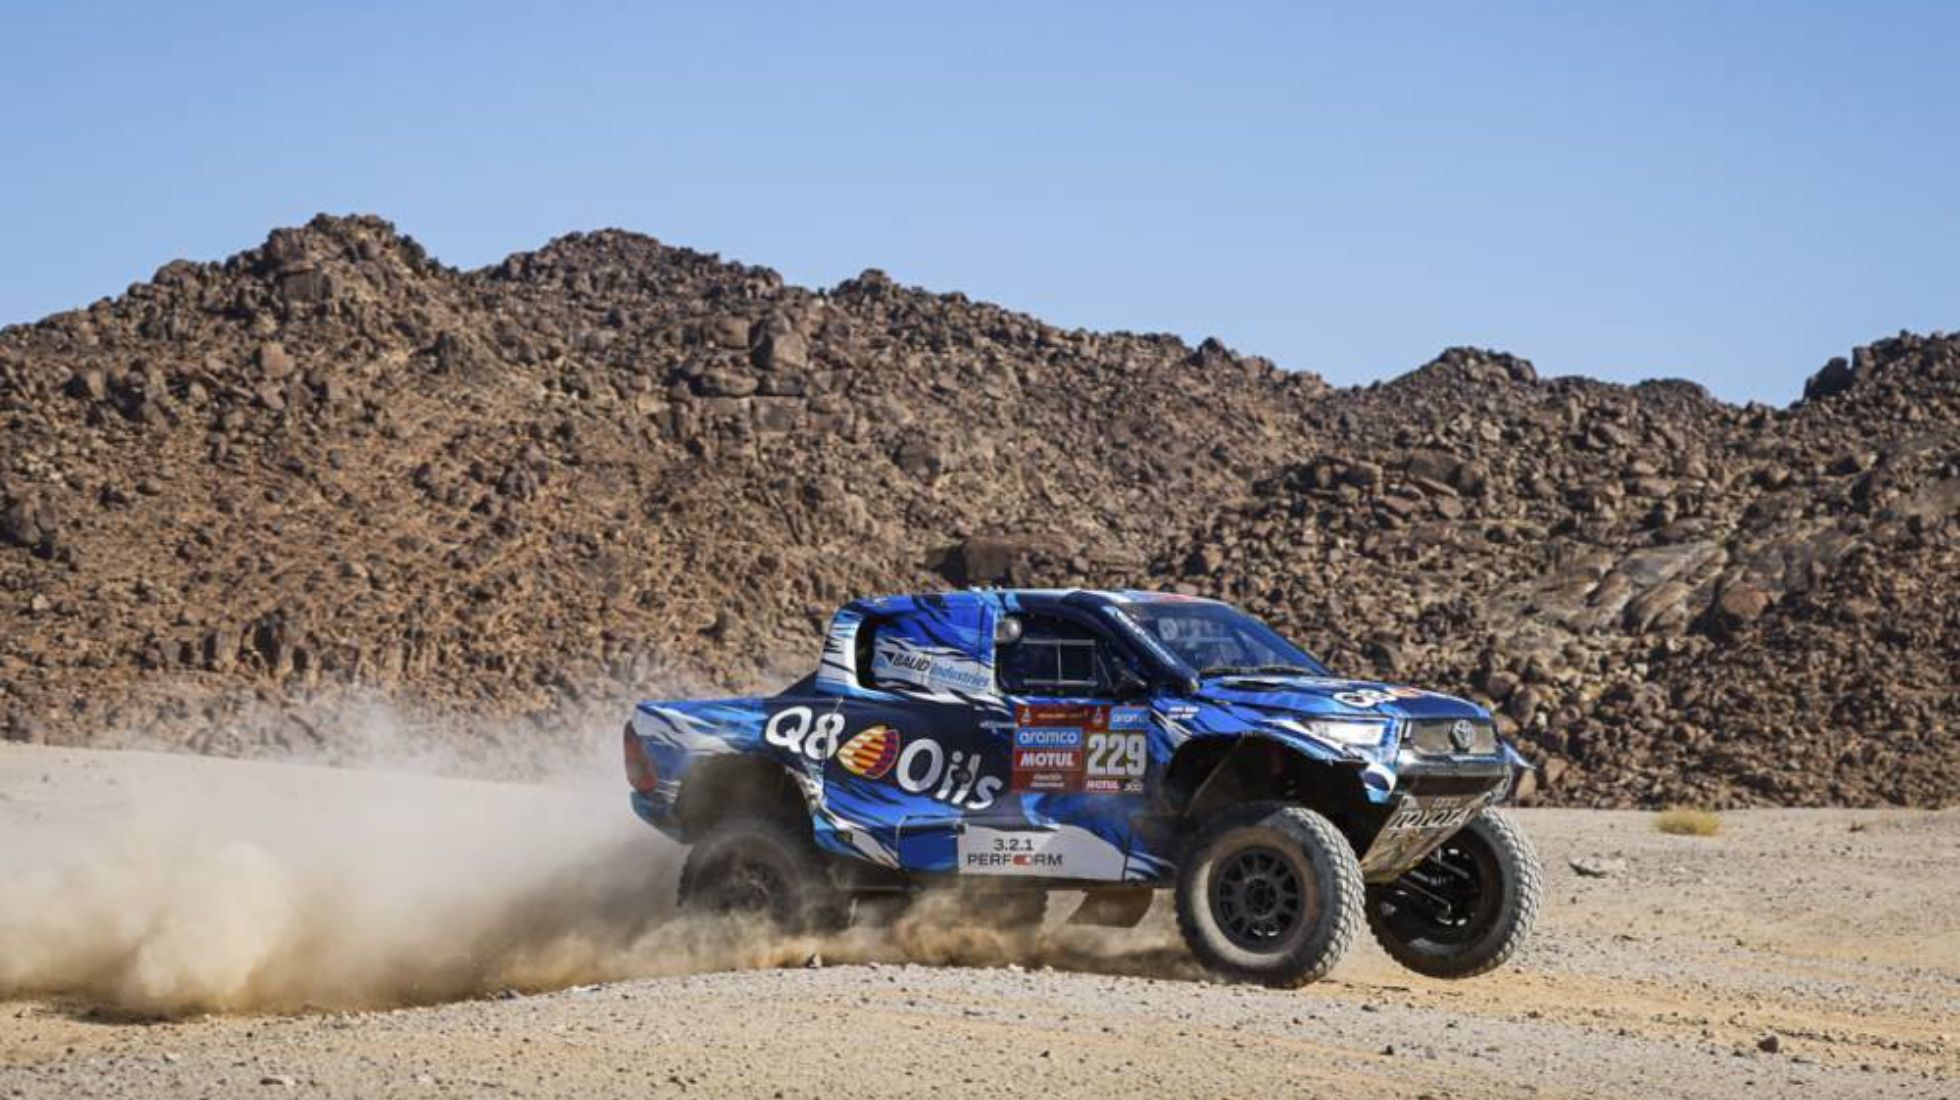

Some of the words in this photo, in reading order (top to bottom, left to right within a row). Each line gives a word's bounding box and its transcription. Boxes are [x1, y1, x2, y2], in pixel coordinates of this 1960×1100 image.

[1019, 731, 1078, 744] aramco
[766, 706, 845, 760] Q8
[896, 738, 1002, 810] Oils
[1020, 752, 1075, 767] MOTUL
[1087, 734, 1147, 776] 229
[993, 839, 1034, 852] 3.2.1
